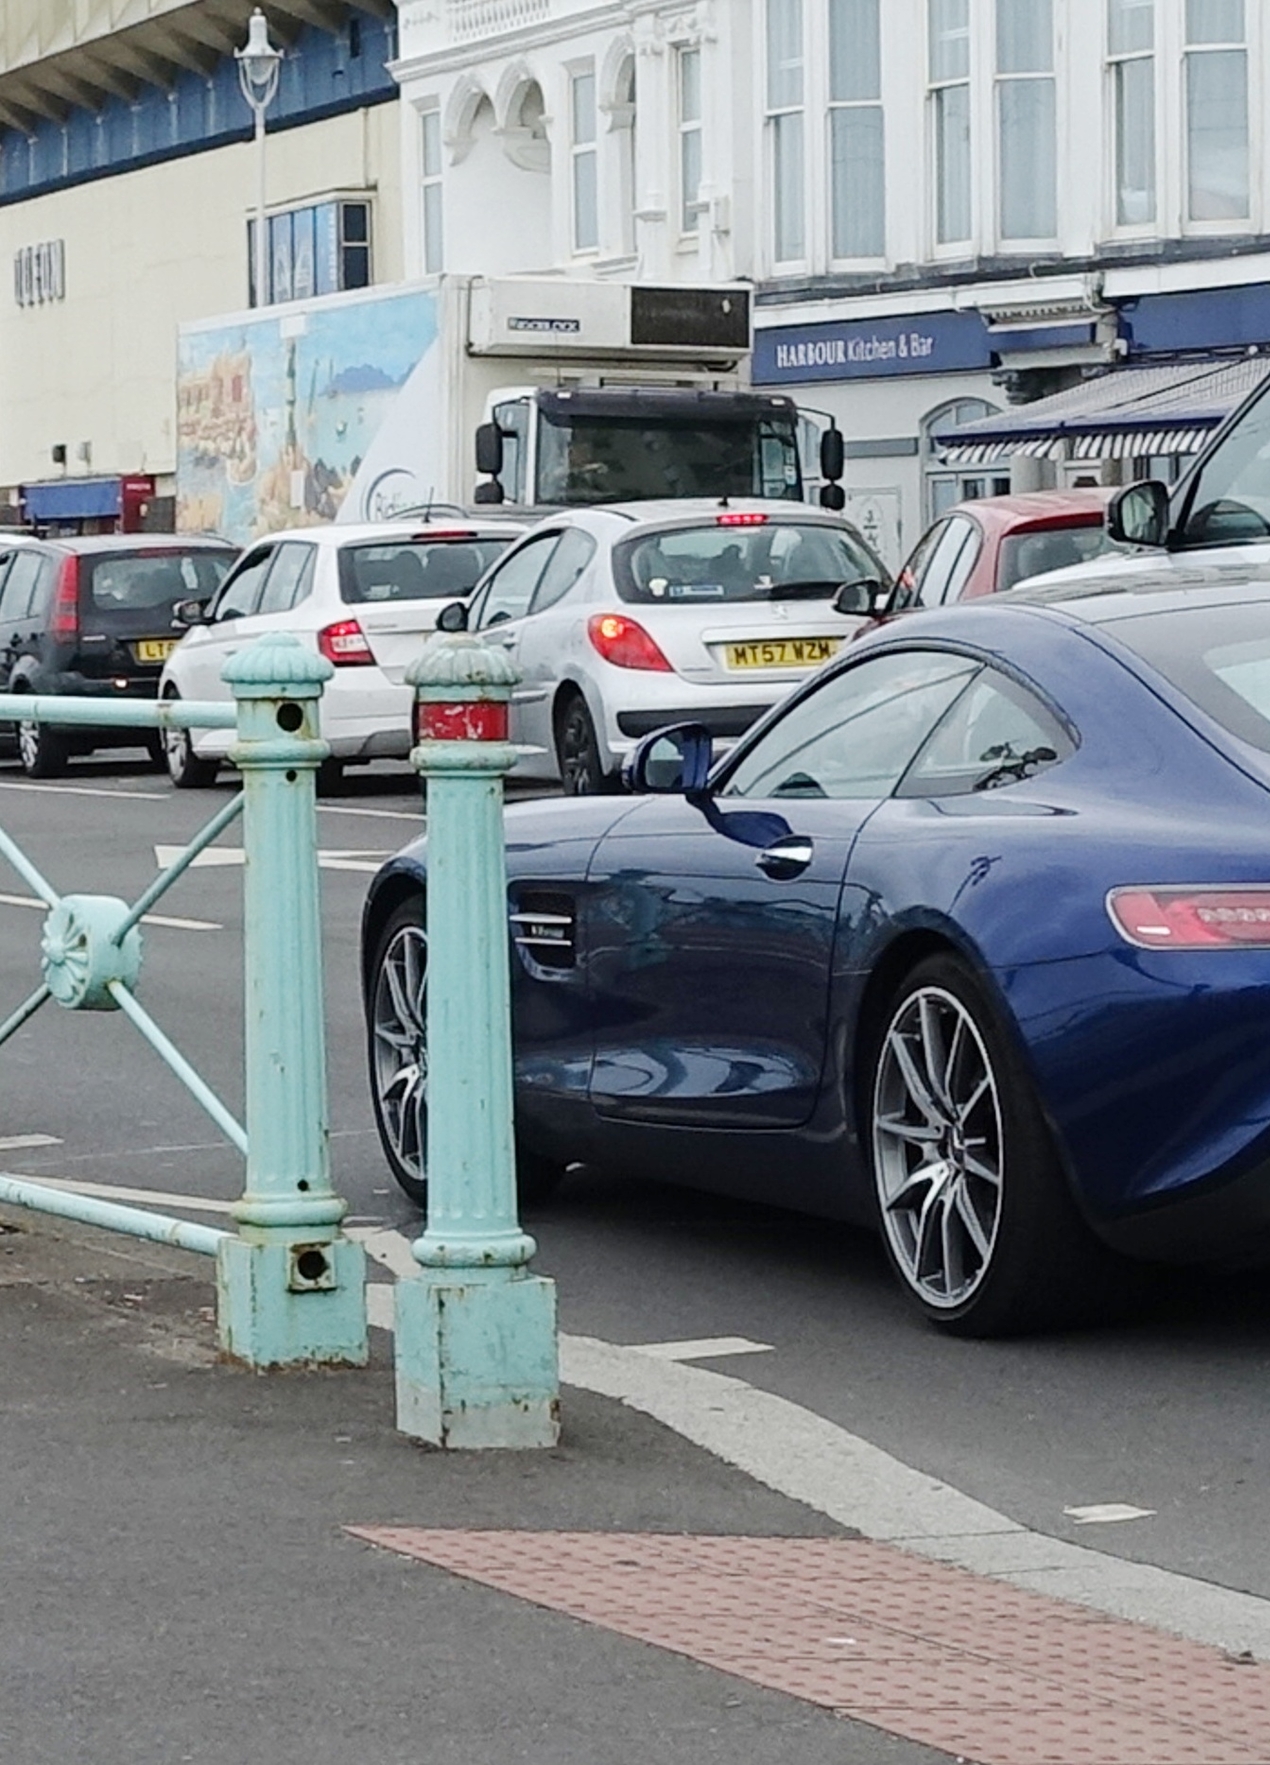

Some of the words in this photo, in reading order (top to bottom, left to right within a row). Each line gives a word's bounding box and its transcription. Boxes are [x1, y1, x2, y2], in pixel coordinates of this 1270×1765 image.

[777, 340, 846, 368] HARBOUR
[848, 335, 895, 361] Kitchen
[898, 334, 908, 358] &
[910, 332, 934, 357] Bar
[734, 644, 785, 665] MT57
